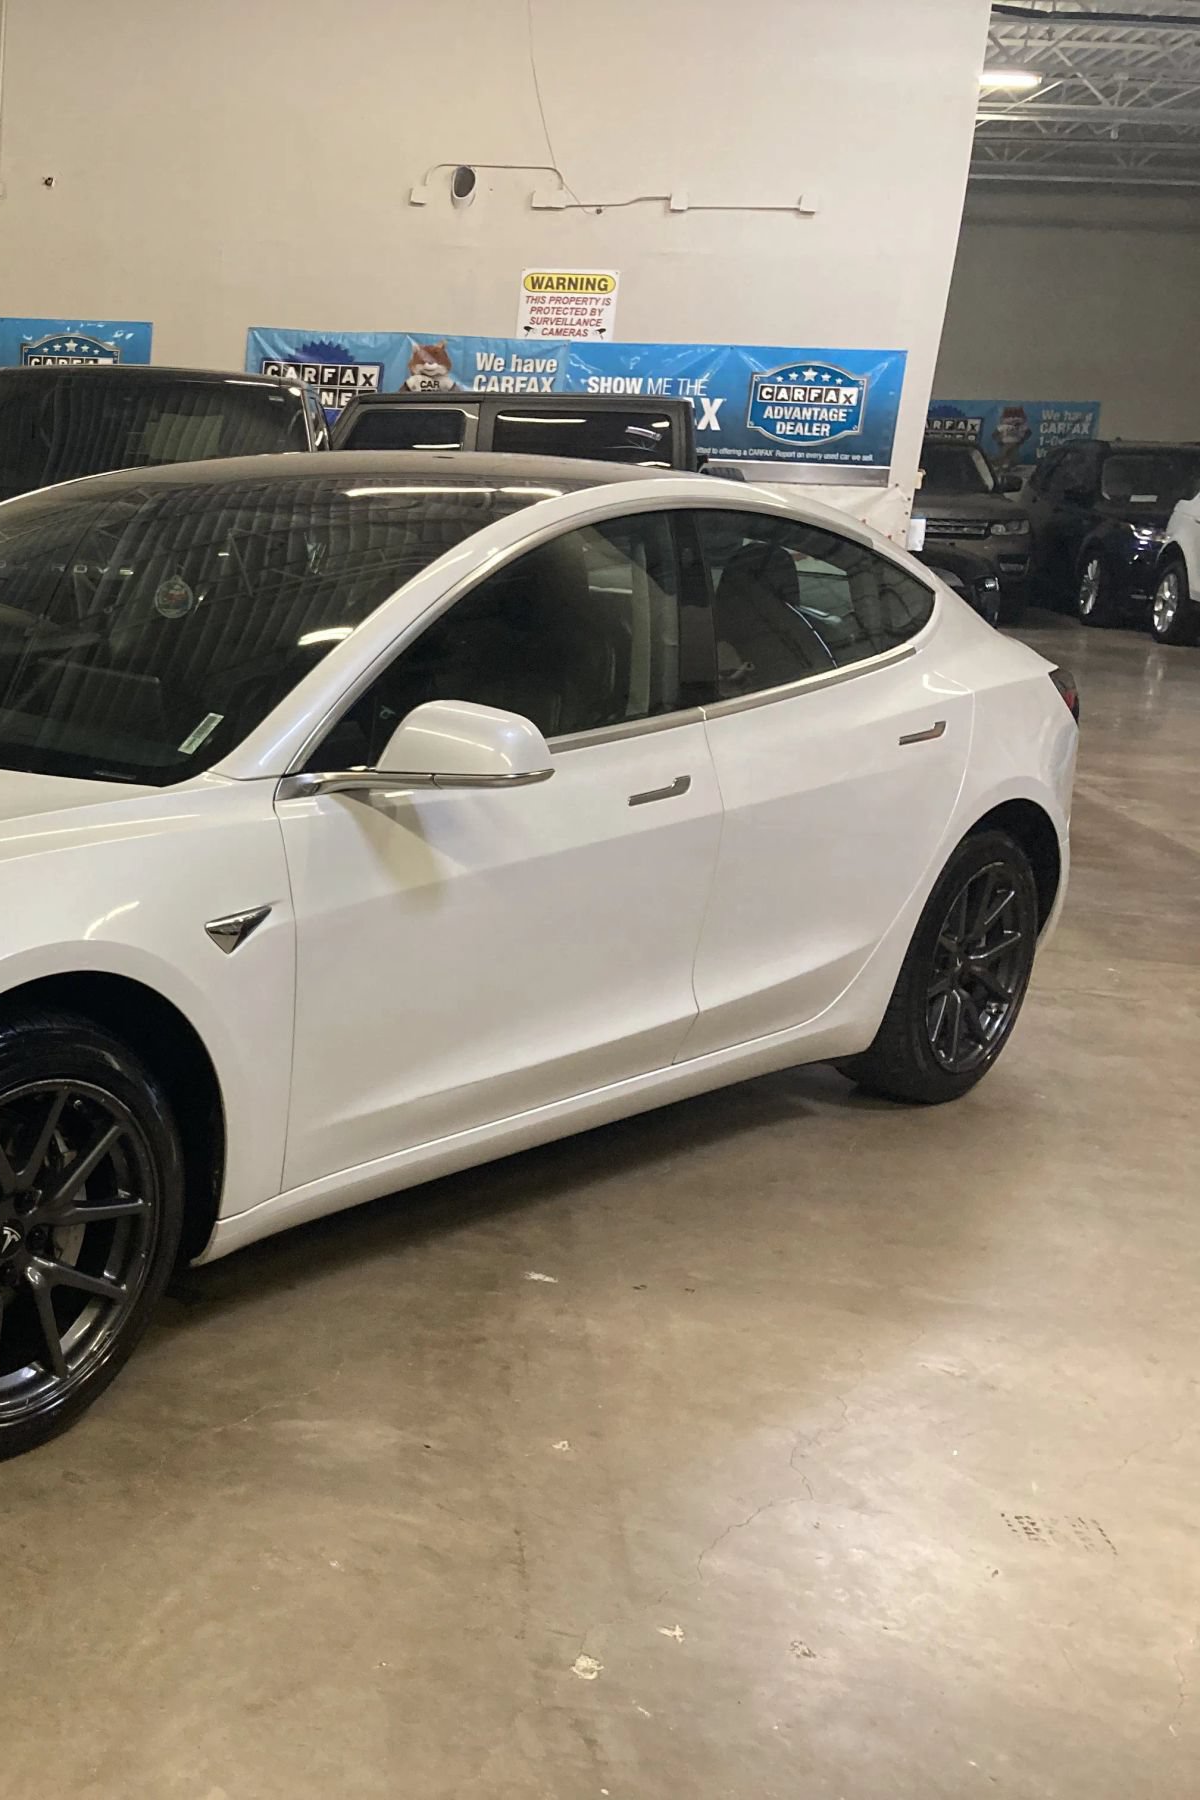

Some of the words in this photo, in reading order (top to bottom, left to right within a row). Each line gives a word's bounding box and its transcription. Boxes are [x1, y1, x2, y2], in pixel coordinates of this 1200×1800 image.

[531, 276, 609, 291] WARNING
[525, 296, 546, 304] THIS
[548, 296, 600, 306] PROPERTY
[602, 297, 611, 306] IS
[529, 306, 588, 316] PROTECTED
[590, 308, 604, 316] BY
[529, 317, 603, 327] SURVEILLANCE
[541, 327, 589, 337] CAMERAS
[476, 352, 505, 371] We
[511, 354, 557, 373] have
[267, 365, 375, 386] CARFAX
[473, 374, 556, 392] CARFAX
[420, 380, 440, 388] CAR
[587, 376, 643, 394] SHOW
[647, 378, 672, 395] ME
[677, 378, 709, 396] THE
[761, 387, 854, 404] CARFAX
[763, 406, 848, 422] ADVANTAGE
[775, 421, 831, 437] DEALER
[926, 420, 978, 431] RFAX
